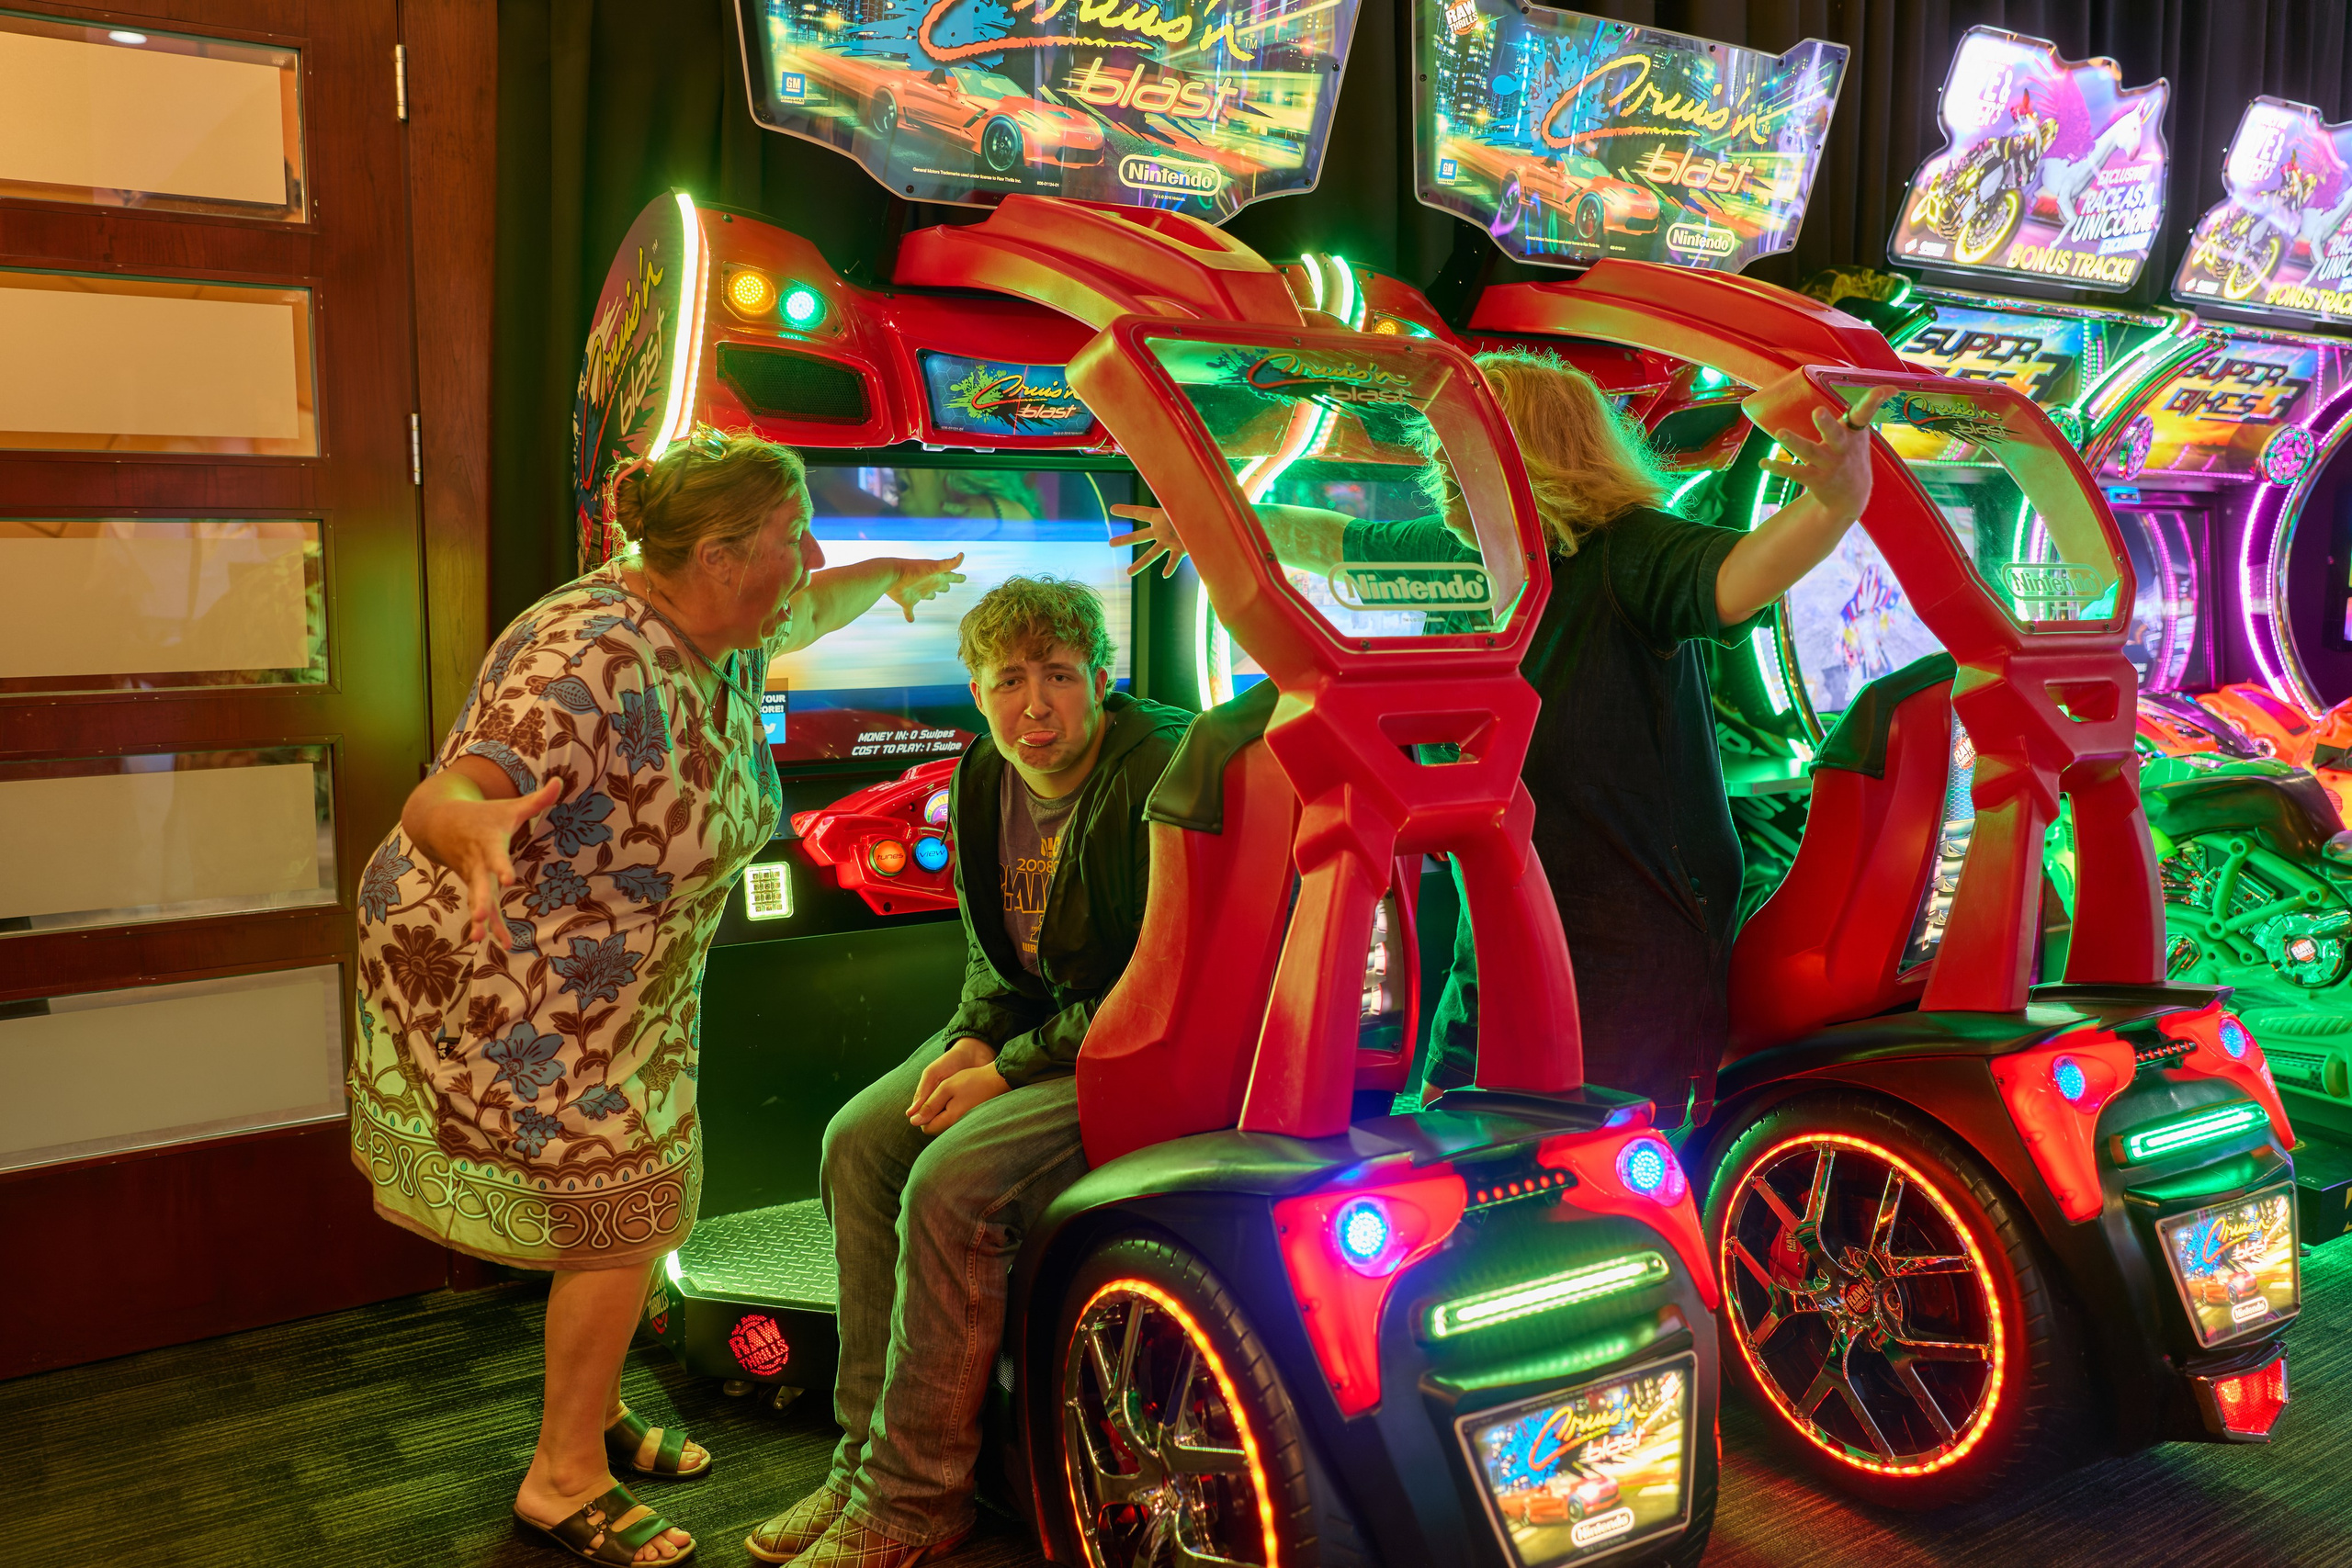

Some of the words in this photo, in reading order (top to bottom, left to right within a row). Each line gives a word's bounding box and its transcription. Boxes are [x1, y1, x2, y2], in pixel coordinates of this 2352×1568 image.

[1445, 0, 1476, 26] RAW
[1449, 12, 1479, 33] THRILLS
[786, 76, 801, 90] GM
[1079, 57, 1238, 120] blast
[1541, 55, 1768, 149] Cruis'n
[1128, 162, 1214, 189] Nintendo
[1645, 142, 1754, 193] blast
[1672, 229, 1730, 251] Nintendo
[2007, 243, 2073, 275] BONUS
[2265, 281, 2318, 310] BONUS
[1902, 326, 2043, 367] SUPER
[582, 246, 664, 491] Cruis'n
[620, 307, 665, 437] blast
[1247, 354, 1411, 389] Cruis'n
[2178, 355, 2289, 390] SUPER
[1329, 384, 1408, 404] blast
[1020, 403, 1077, 419] blast
[1904, 395, 2003, 424] Cruis'n
[1955, 421, 2009, 437] blast
[1343, 573, 1485, 600] Nintendo
[2011, 572, 2098, 592] Nintendo
[760, 705, 785, 714] ORE!
[851, 745, 881, 756] COST
[882, 744, 897, 754] TO
[896, 743, 925, 754] PLAY:
[932, 741, 963, 751] Swipe
[857, 731, 894, 742] MONEY
[894, 730, 910, 740] IN:
[919, 729, 956, 739] Swipes
[876, 852, 904, 861] tunes
[919, 850, 945, 858] view
[2202, 1211, 2271, 1264] Cruis'n
[2234, 1235, 2270, 1261] blast
[1846, 1283, 1868, 1307] RAW
[2233, 1301, 2266, 1319] Nintendo
[728, 1317, 781, 1359] RAW
[738, 1338, 790, 1371] THRILLS
[1528, 1393, 1649, 1472] Cruis'n
[1584, 1425, 1645, 1462] blast
[1575, 1512, 1632, 1542] Nintendo
